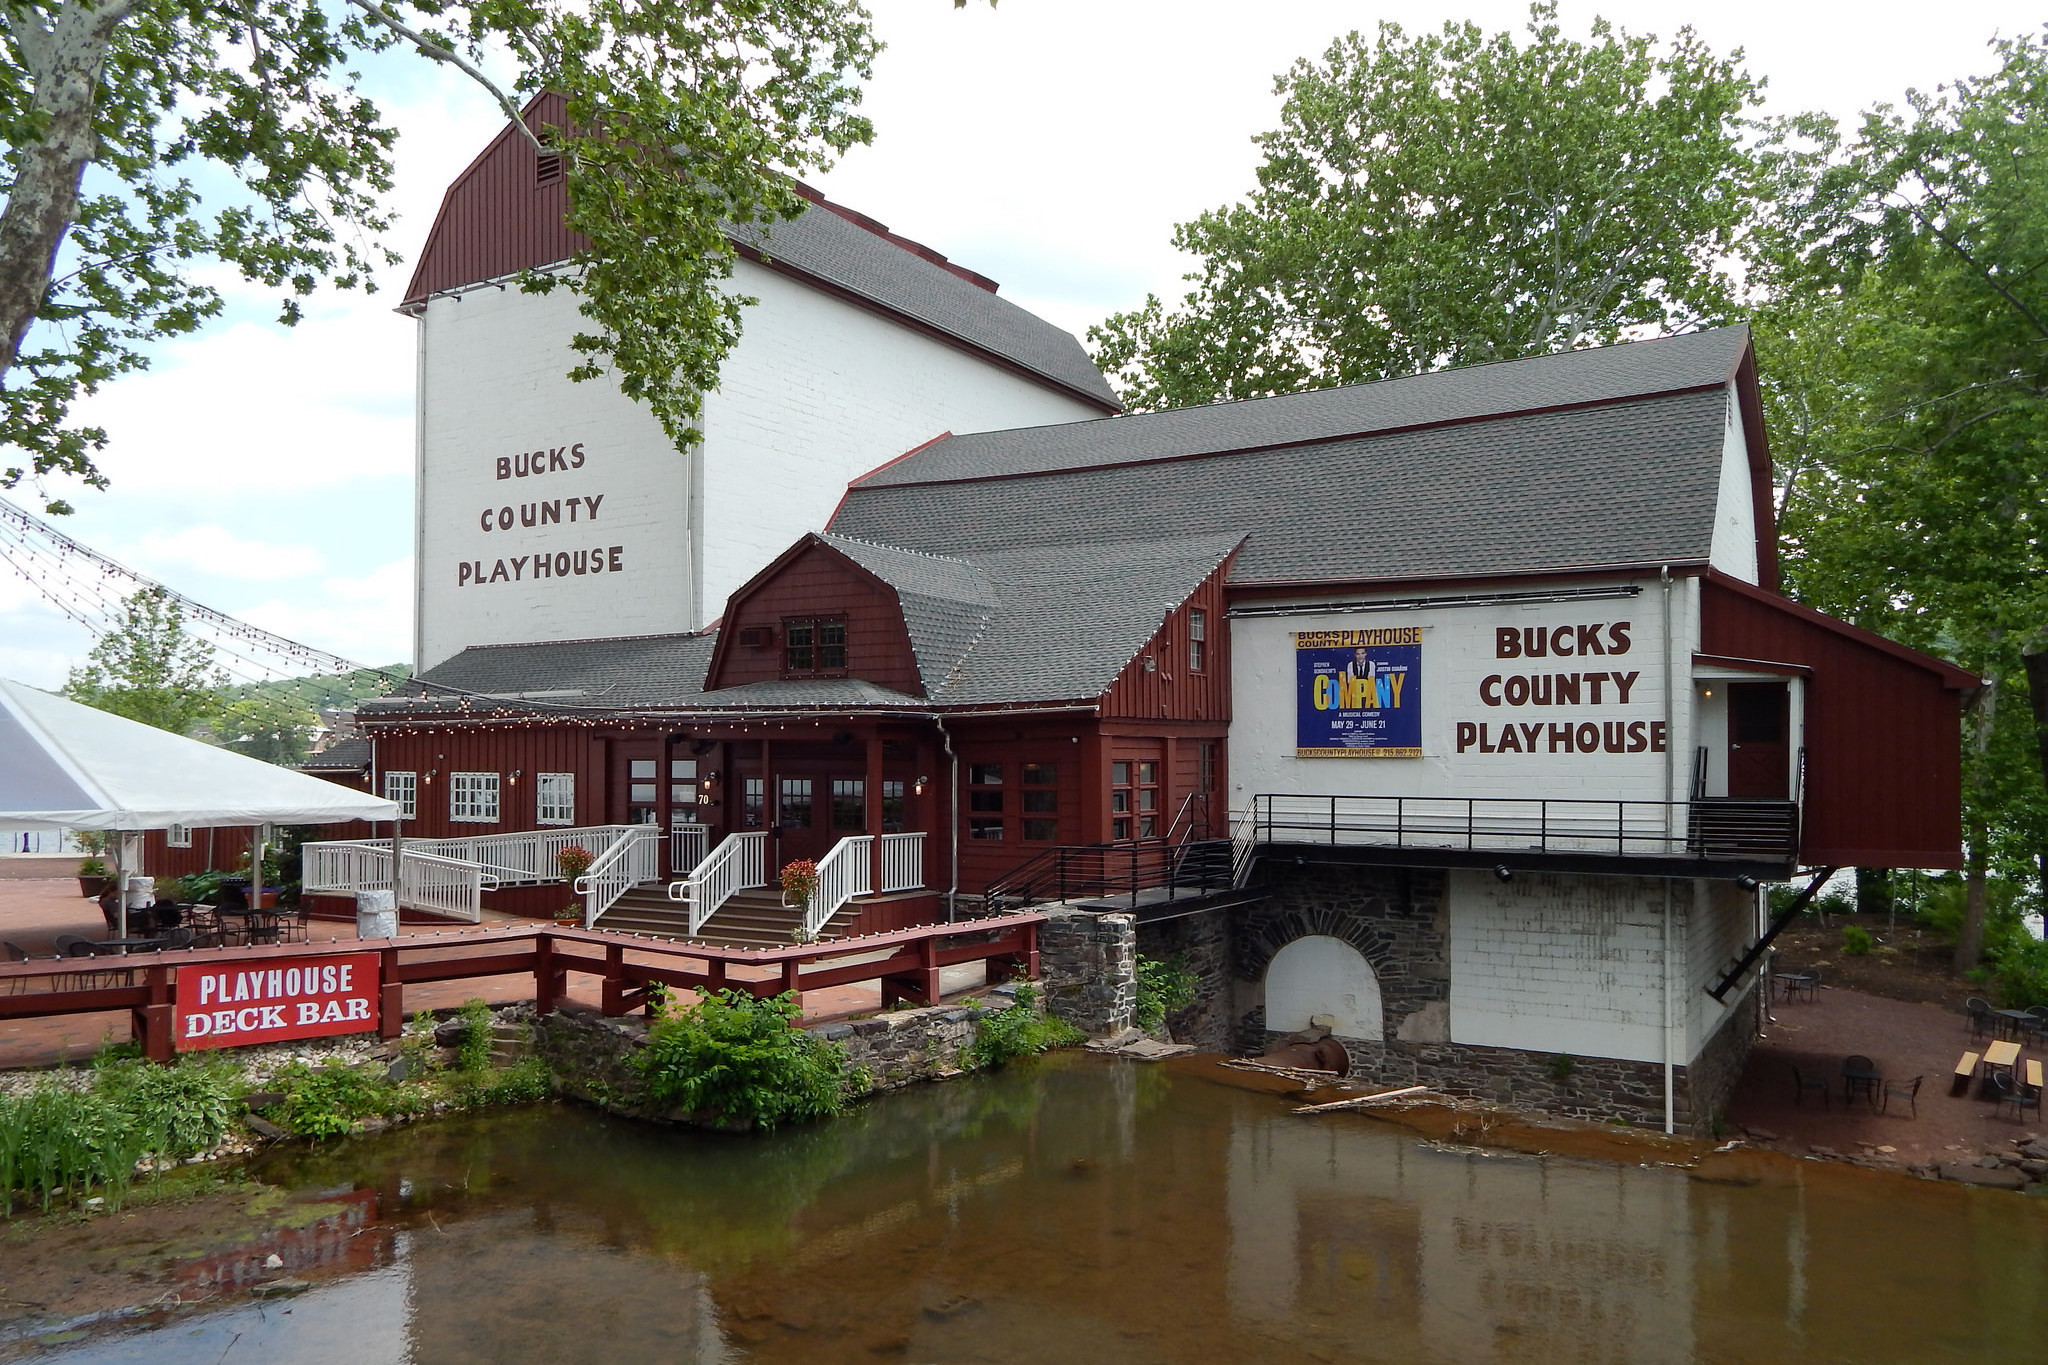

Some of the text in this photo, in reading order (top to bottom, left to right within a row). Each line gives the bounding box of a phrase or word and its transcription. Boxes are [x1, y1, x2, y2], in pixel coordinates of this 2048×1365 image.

[496, 442, 585, 480] BUCKS
[480, 494, 604, 532] COUNTY
[458, 545, 623, 587] PLAYHOUSE
[1298, 630, 1340, 640] BUCKS
[1298, 639, 1339, 648] COUNTY
[1341, 627, 1420, 646] PLAYHOUSE
[1496, 621, 1631, 659] BUCKS
[1313, 671, 1406, 710] COMPANY
[1479, 671, 1641, 707] COUNTY
[1331, 720, 1344, 729] MAY
[1345, 720, 1354, 729] 29
[1360, 720, 1377, 729] JUNE
[1378, 720, 1386, 729] 21
[1456, 721, 1666, 753] PLAYHOUSE
[698, 794, 709, 805] 70
[200, 964, 353, 1005] PLAYHOUSE
[185, 998, 371, 1038] DECK BAR
